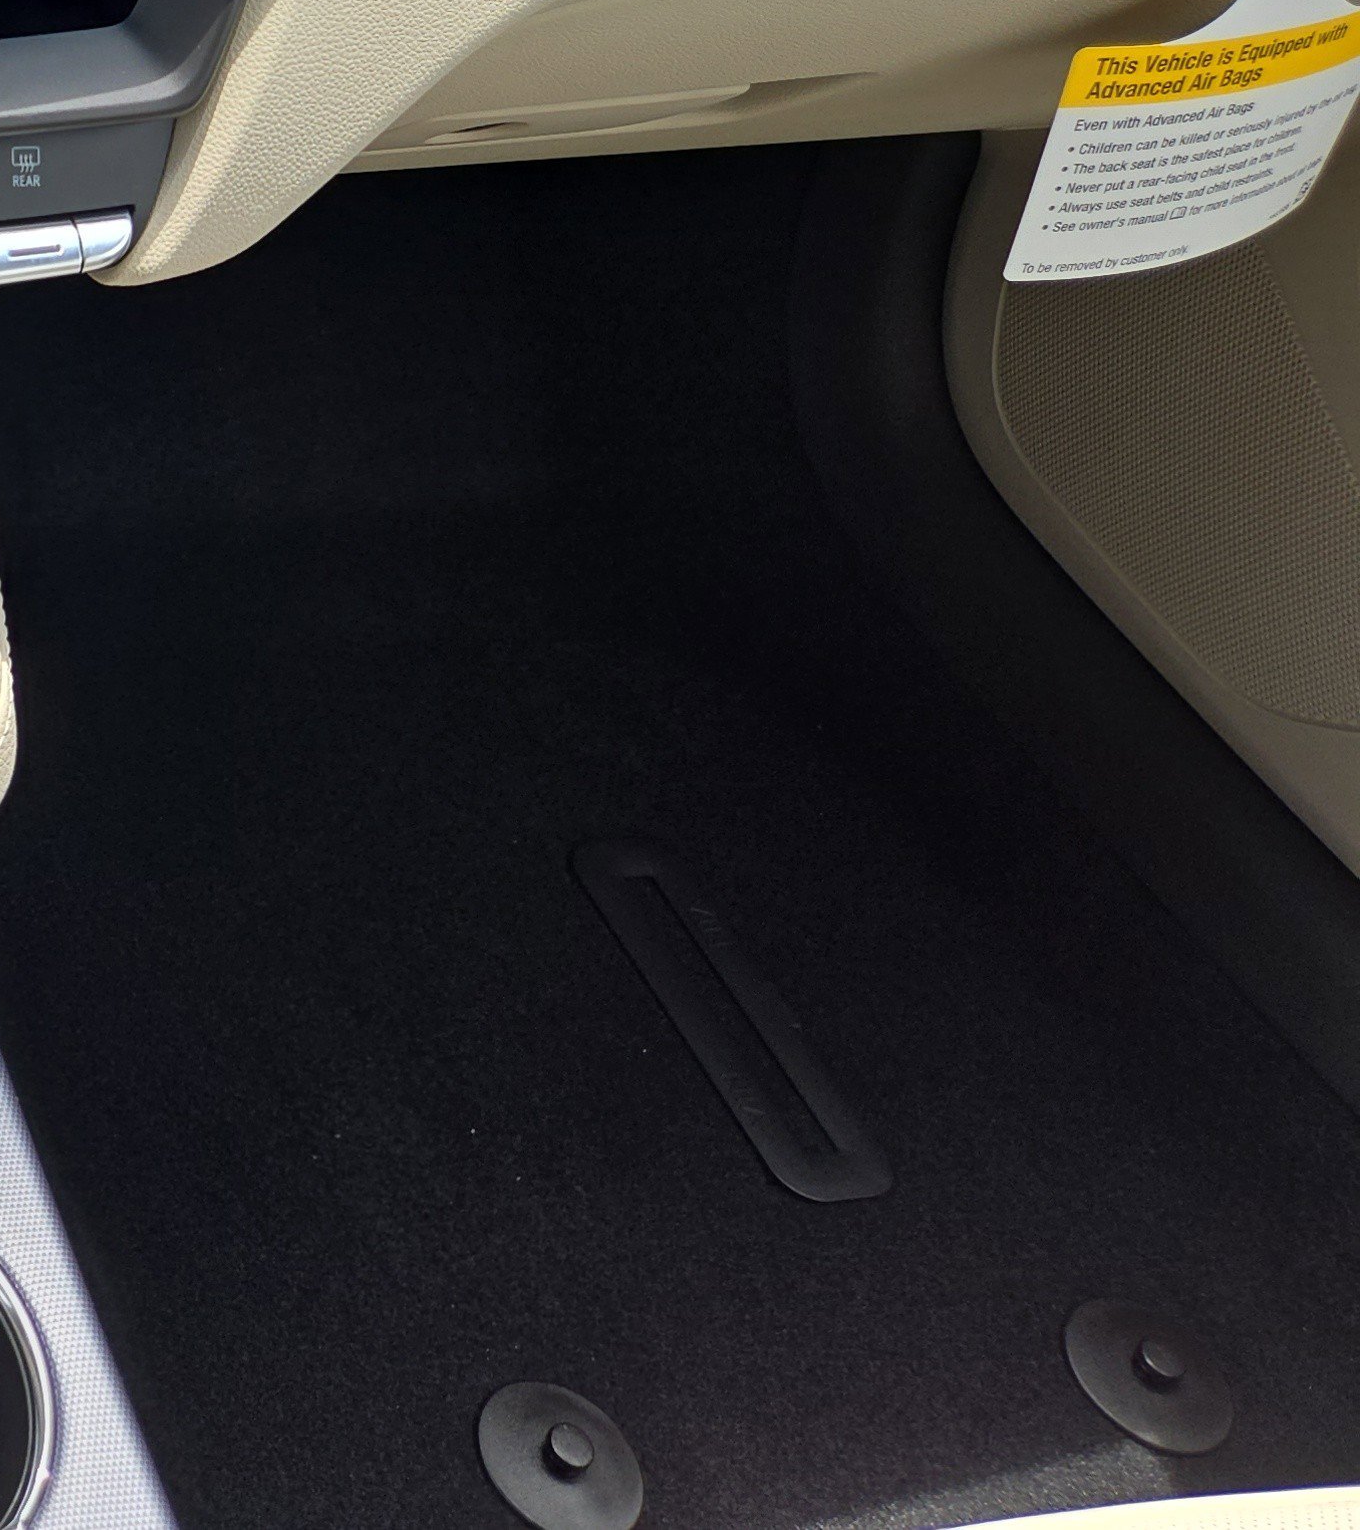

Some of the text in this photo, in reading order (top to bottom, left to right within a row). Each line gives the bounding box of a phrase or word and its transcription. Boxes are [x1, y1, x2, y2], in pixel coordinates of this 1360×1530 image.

[1096, 23, 1349, 76] This Vehicle is Equipped with
[1085, 66, 1263, 100] Advanced Air Bags
[1074, 102, 1255, 131] Even with Advanced Air Bags
[1078, 142, 1132, 155] Children
[1135, 139, 1158, 151] can
[1161, 136, 1176, 148] be
[1179, 130, 1211, 145] killed
[1213, 129, 1226, 141] or
[1226, 118, 1274, 138] seriously
[1073, 162, 1097, 174] The
[1098, 159, 1128, 173] back
[1130, 157, 1156, 170] seat
[1158, 155, 1168, 167] is
[1170, 153, 1188, 165] the
[1190, 146, 1223, 162] safest
[1223, 140, 1251, 158] place
[1252, 137, 1268, 150] for
[12, 174, 41, 188] REAR
[1065, 182, 1101, 195] Never
[1103, 179, 1125, 194] put
[1126, 180, 1135, 190] a
[1136, 168, 1198, 189] rear-facing
[1200, 163, 1226, 179] child
[1226, 158, 1249, 172] seat
[1058, 201, 1104, 215] Always
[1106, 198, 1130, 210] use
[1129, 194, 1156, 208] seat
[1156, 190, 1183, 205] belts
[1185, 185, 1206, 200] and
[1206, 180, 1231, 195] child
[1052, 221, 1076, 233] See
[1078, 217, 1125, 231] owner's
[1127, 210, 1169, 226] manual
[1189, 204, 1204, 216] for
[1021, 262, 1035, 274] To
[1037, 262, 1051, 273] be
[1054, 258, 1104, 273] removed
[1105, 255, 1119, 269] by
